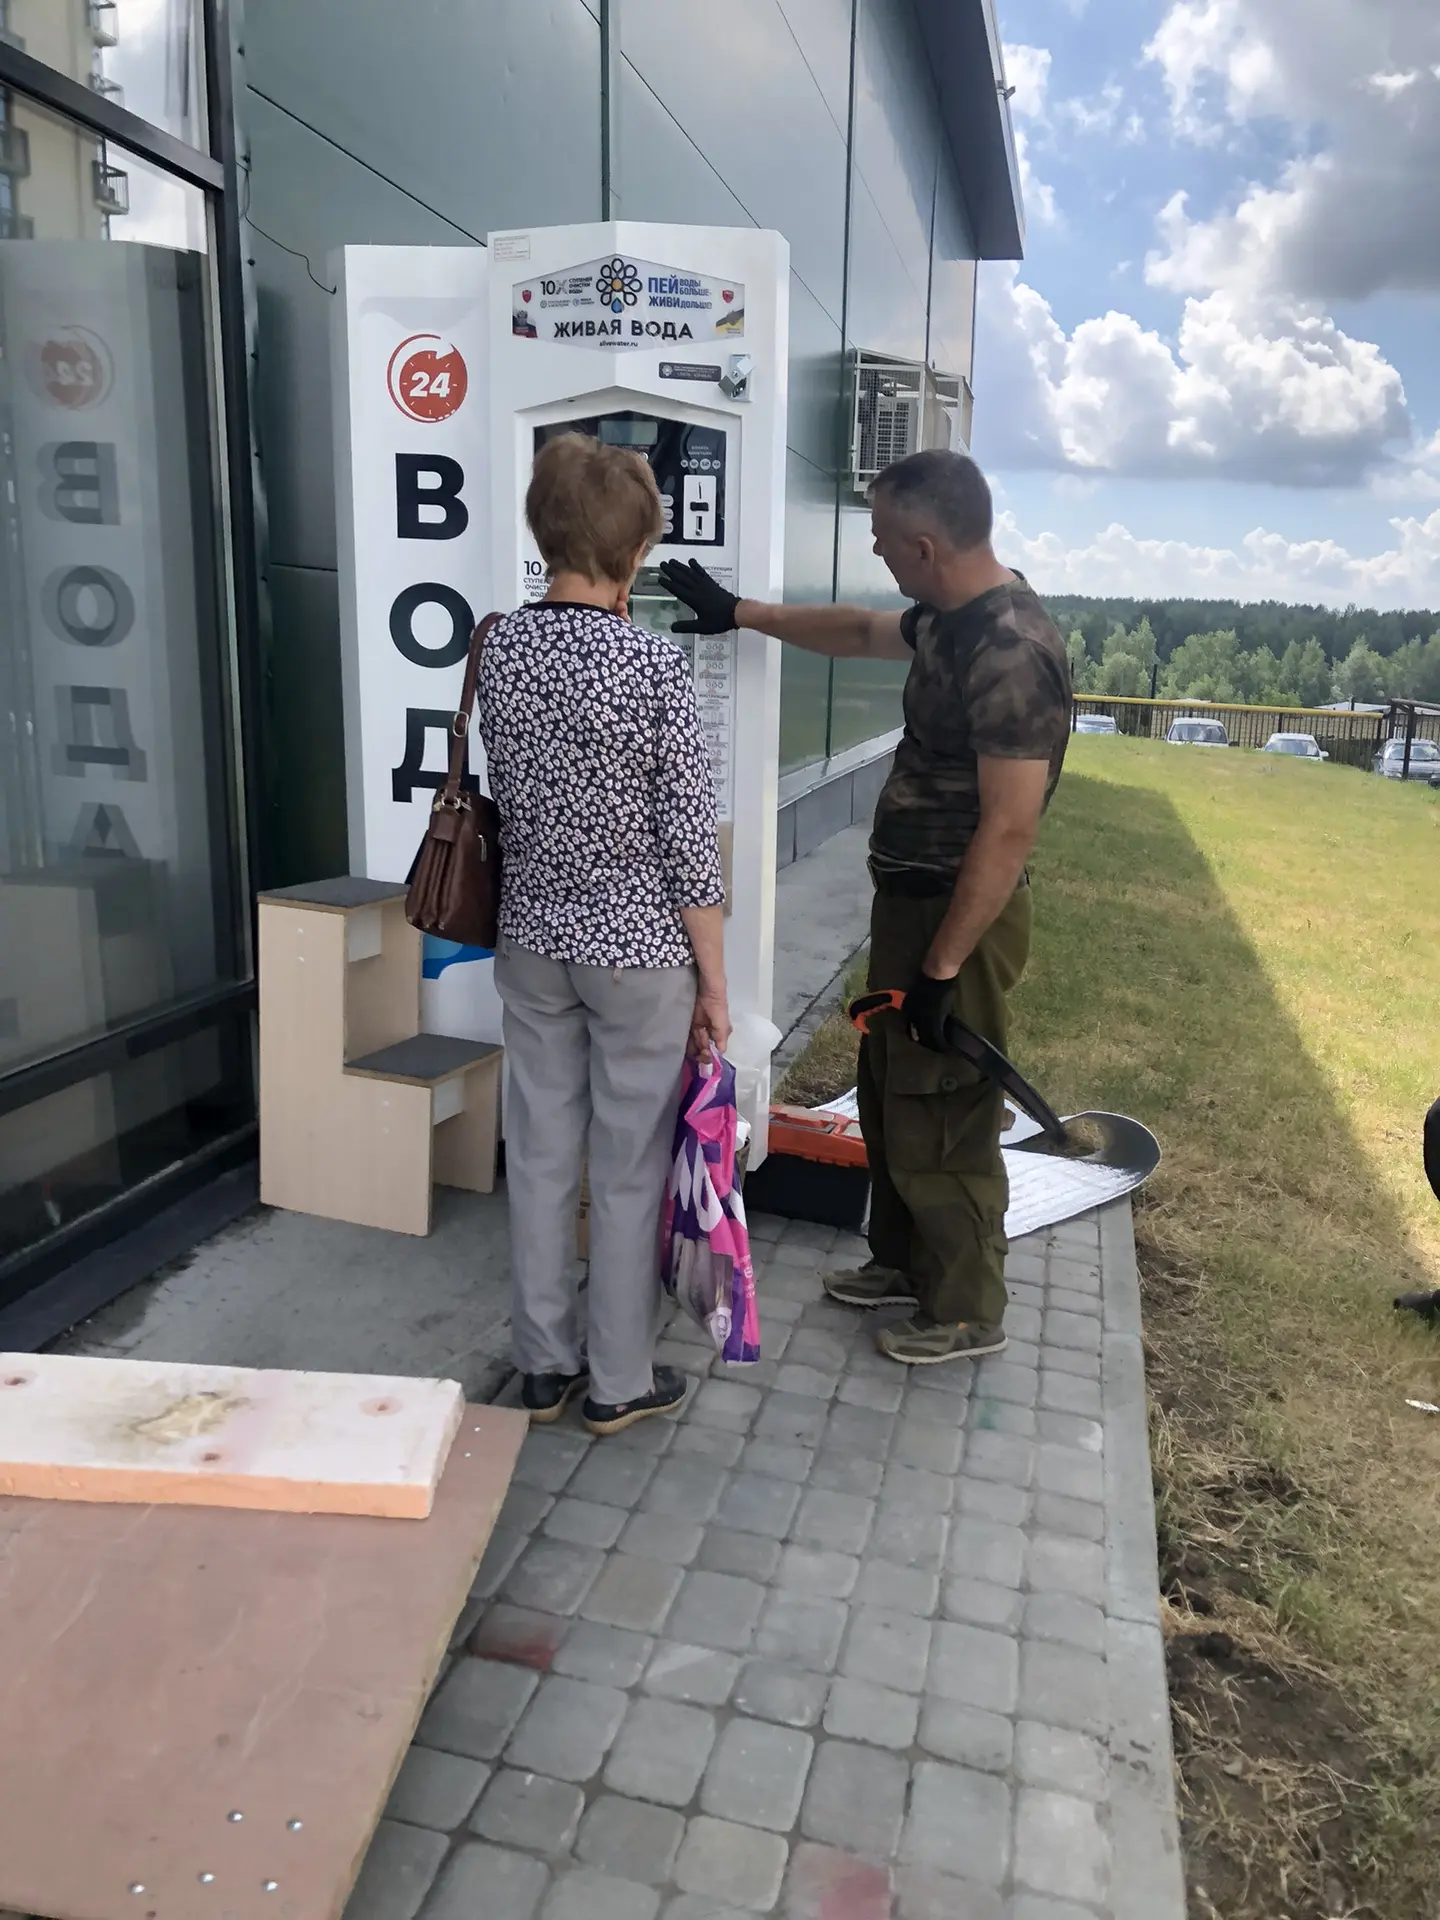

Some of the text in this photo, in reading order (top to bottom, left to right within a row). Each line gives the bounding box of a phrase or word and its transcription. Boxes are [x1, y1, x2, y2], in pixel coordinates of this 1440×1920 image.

[647, 274, 679, 295] ПЕЙ
[648, 295, 680, 308] ЖИВИ
[553, 319, 694, 341] ЖИВАЯ ВОДА
[408, 371, 451, 398] 24
[524, 560, 545, 576] 10
[525, 583, 548, 591] ОЧИСТ
[389, 452, 482, 884] ВОД
